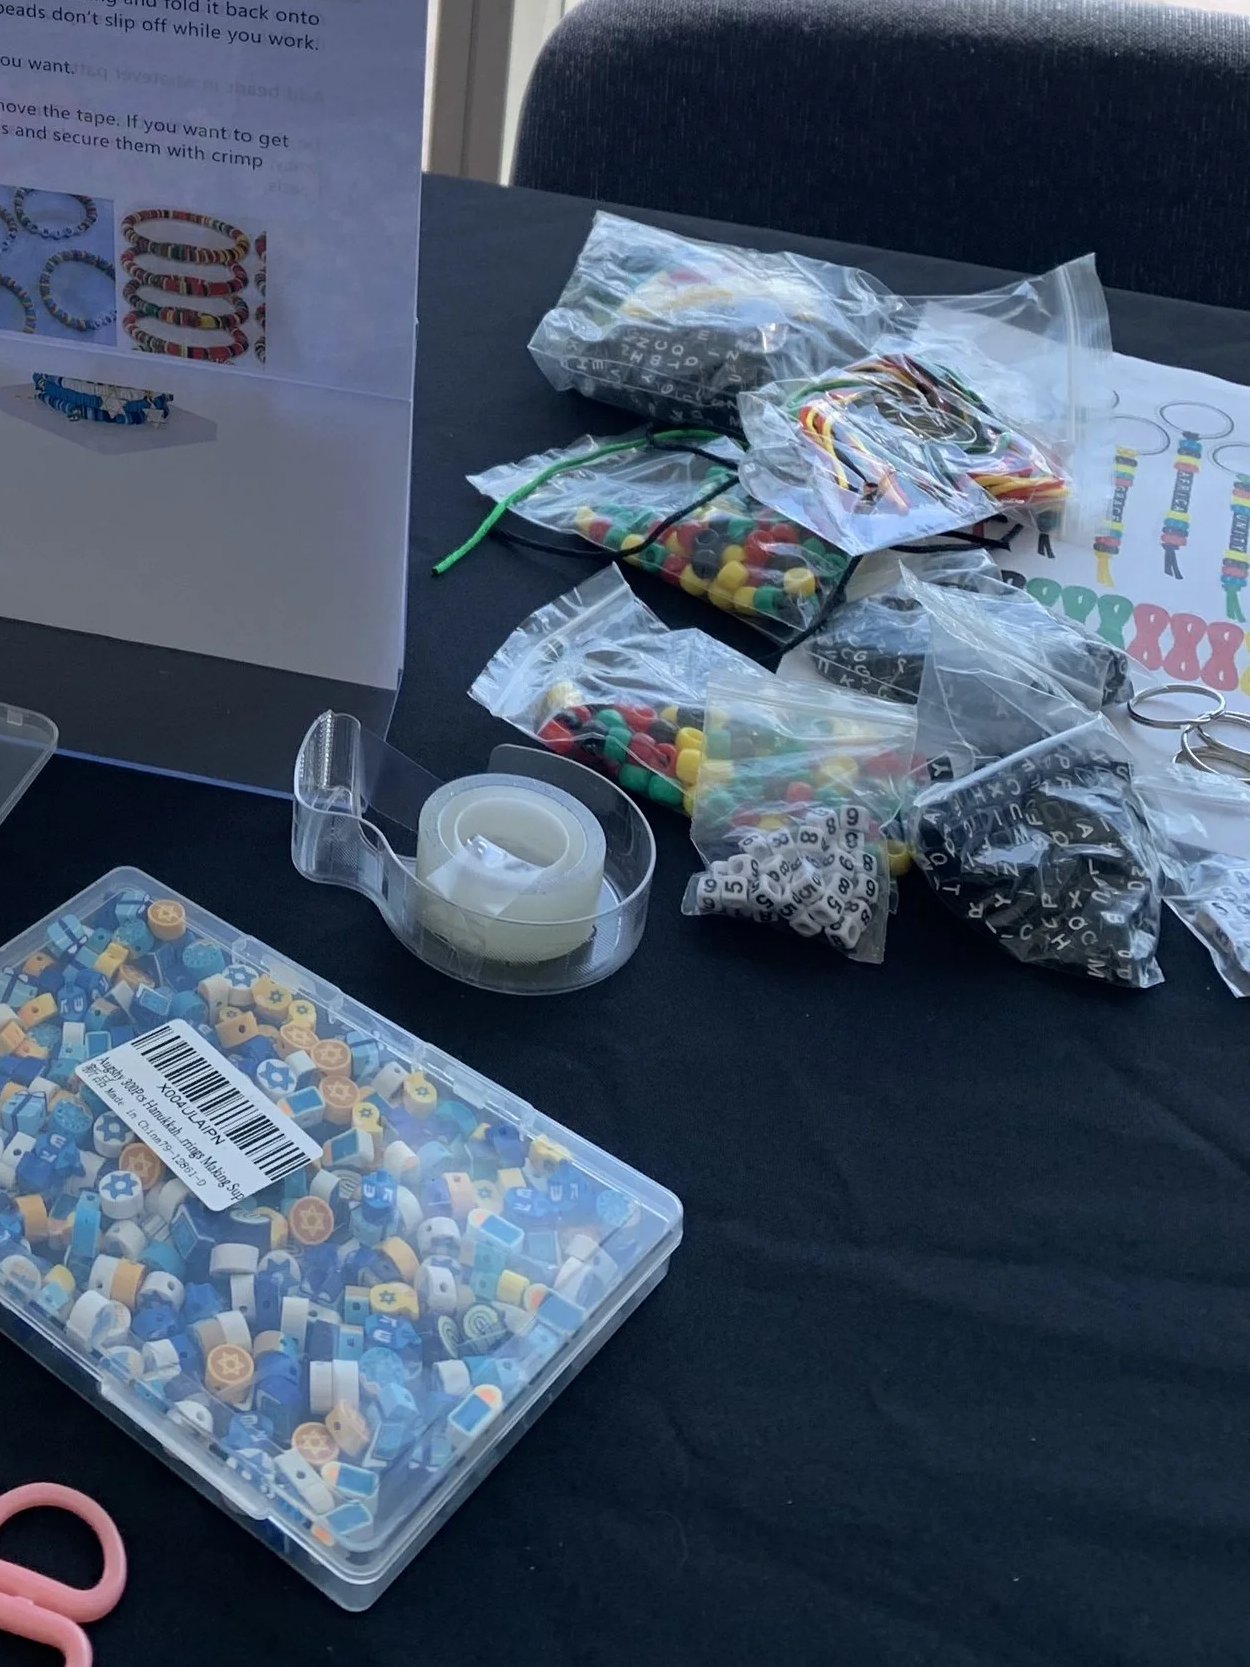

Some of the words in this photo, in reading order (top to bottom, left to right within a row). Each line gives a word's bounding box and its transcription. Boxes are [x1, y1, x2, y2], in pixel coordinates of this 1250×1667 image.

[52, 7, 98, 25] don't
[105, 12, 135, 32] slip
[142, 17, 167, 32] off
[174, 21, 220, 39] while
[228, 27, 261, 44] you
[269, 31, 318, 50] work.
[207, 0, 219, 15] it
[226, 1, 268, 20] back
[276, 8, 319, 25] onto
[29, 58, 75, 75] want.
[43, 105, 69, 119] the
[77, 109, 119, 127] tape.
[127, 114, 144, 129] If
[144, 117, 176, 134] you
[183, 124, 227, 140] want
[234, 128, 252, 142] to
[259, 132, 289, 148] get
[15, 124, 47, 140] and
[54, 130, 109, 148] secure
[116, 135, 161, 155] them
[167, 144, 204, 160] with
[212, 151, 263, 170] crimp
[82, 1063, 111, 1088] 新品
[105, 1088, 124, 1106] Made
[126, 1108, 137, 1119] in
[97, 1057, 125, 1081] Augshy
[121, 1079, 147, 1102] 300Pcs
[201, 1156, 231, 1188] Making
[227, 1183, 245, 1201] Sup
